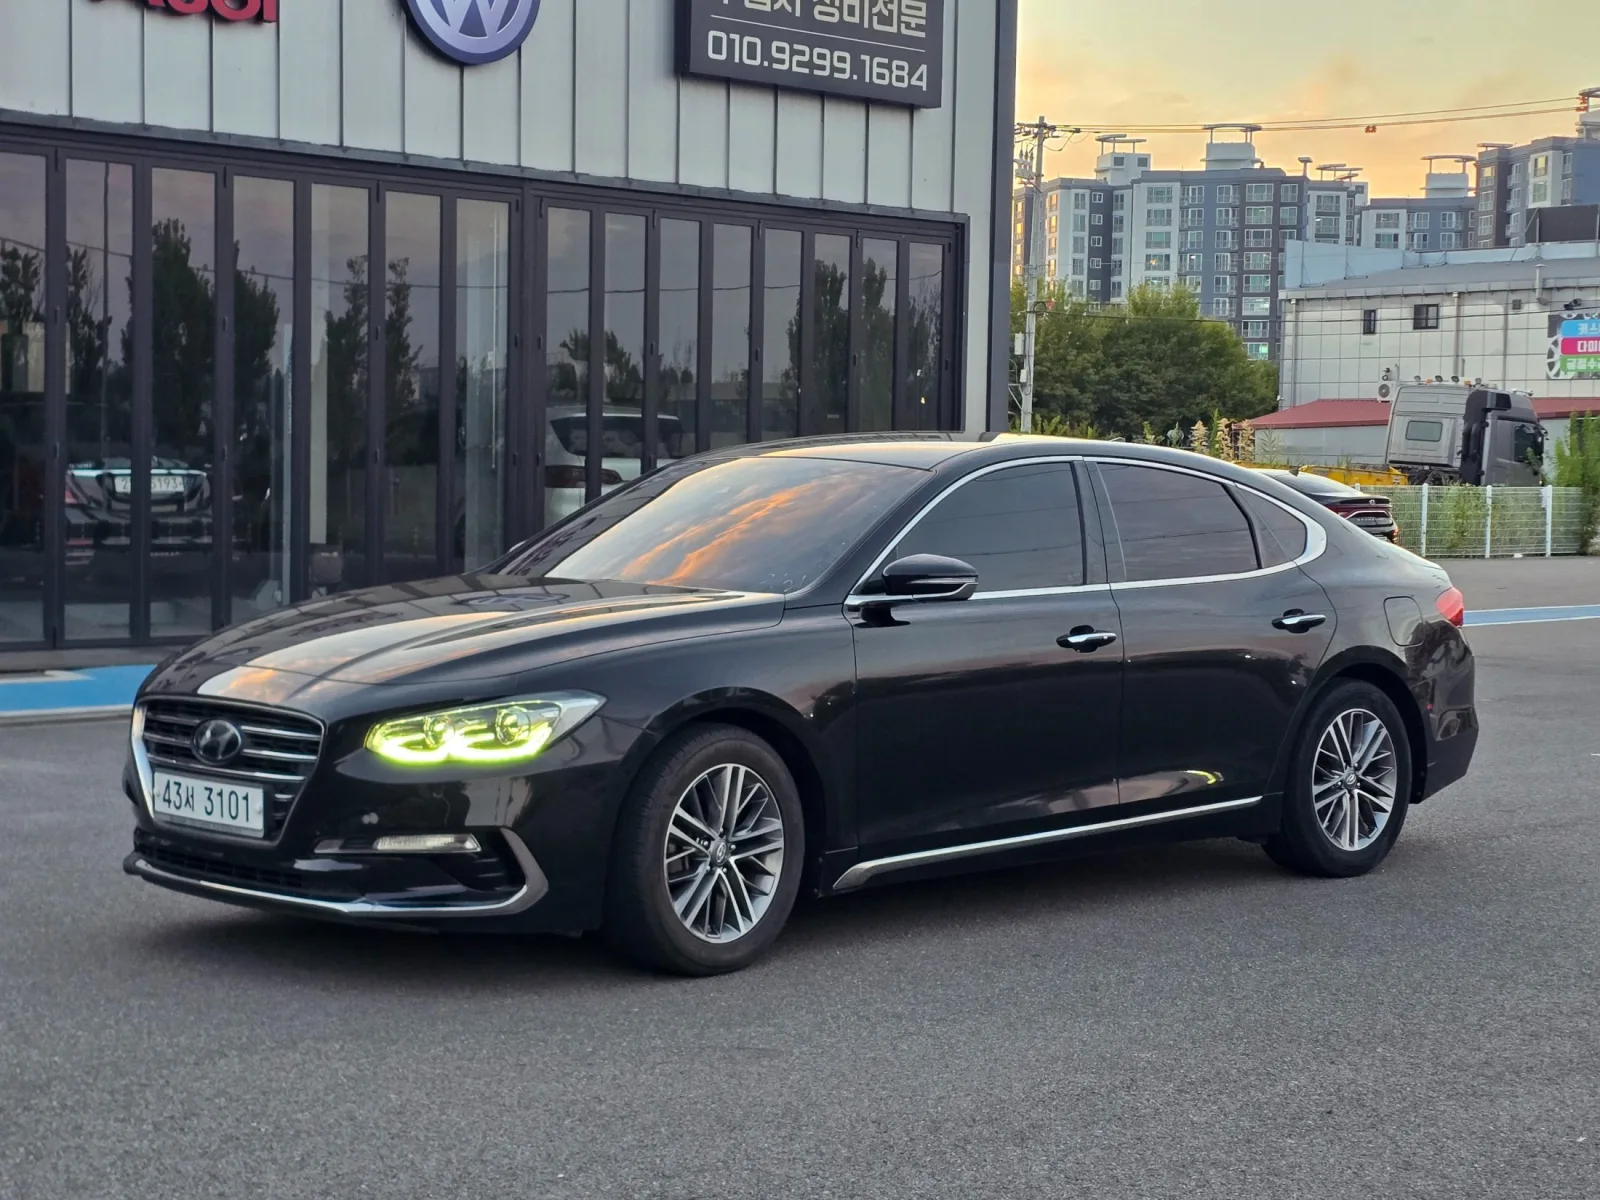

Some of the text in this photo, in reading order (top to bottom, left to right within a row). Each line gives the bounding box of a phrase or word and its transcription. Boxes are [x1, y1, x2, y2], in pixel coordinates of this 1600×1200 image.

[707, 30, 927, 91] 010.9299.1684
[1577, 340, 1600, 353] 다이
[162, 779, 249, 823] 43서 3101
